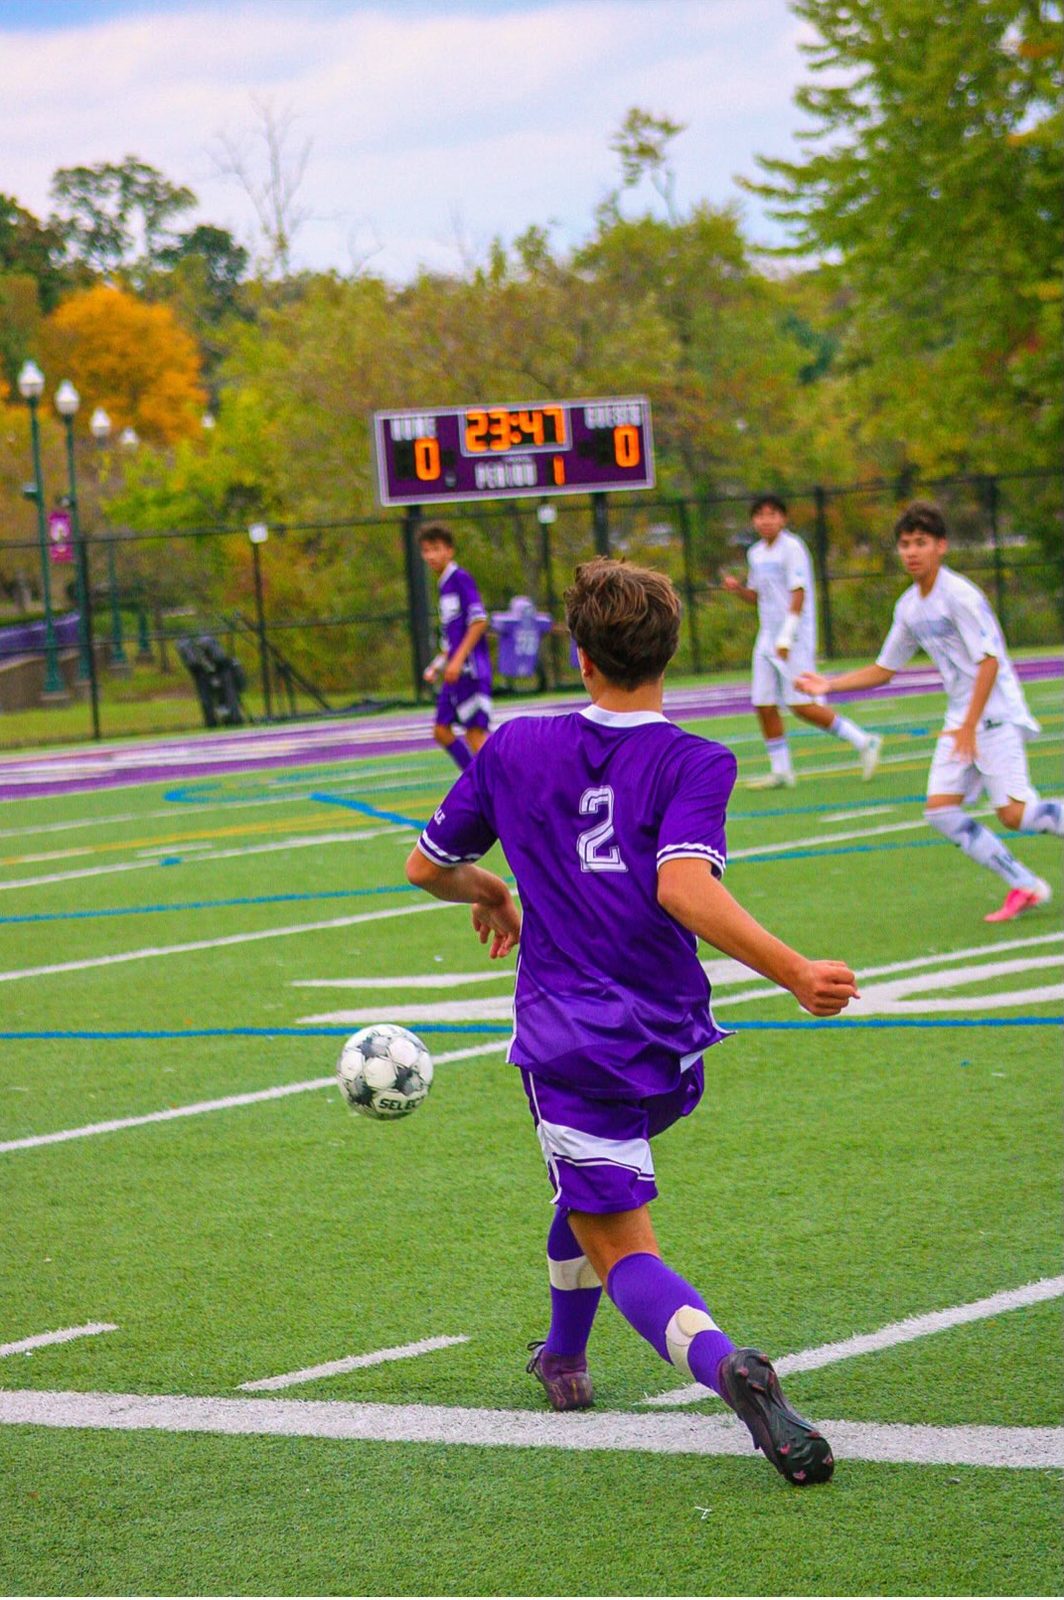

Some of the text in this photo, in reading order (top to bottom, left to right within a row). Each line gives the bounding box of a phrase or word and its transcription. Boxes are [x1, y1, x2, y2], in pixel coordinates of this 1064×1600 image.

[465, 405, 566, 452] 23:47
[613, 425, 640, 467] 0
[414, 437, 441, 481] 0
[577, 785, 628, 872] 2
